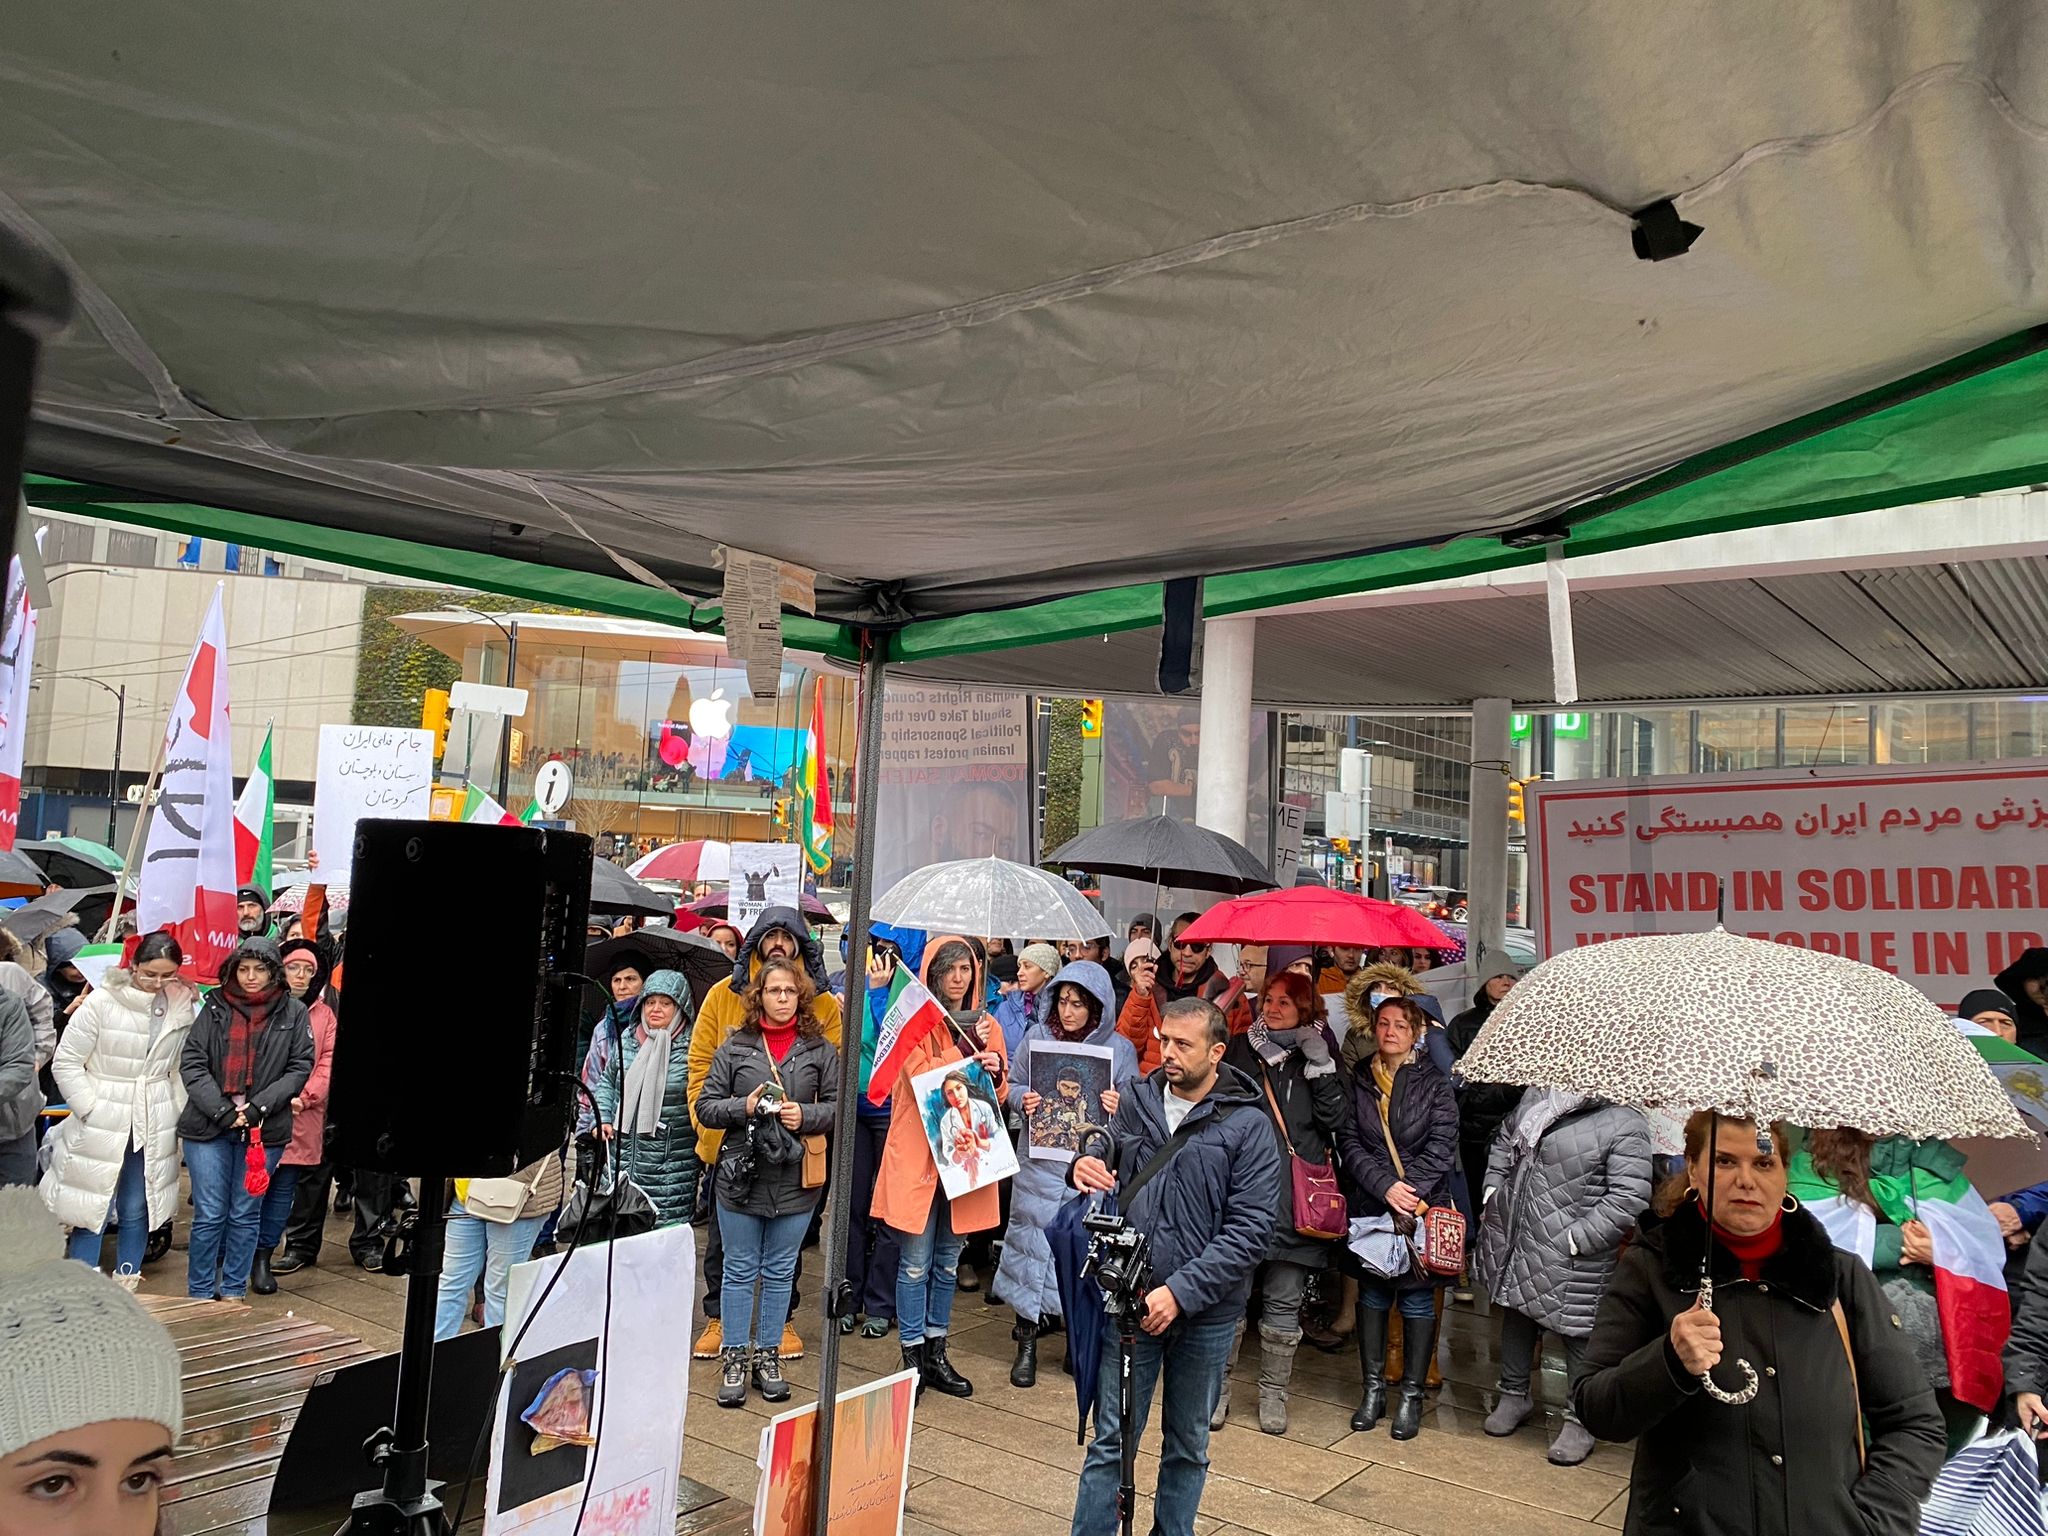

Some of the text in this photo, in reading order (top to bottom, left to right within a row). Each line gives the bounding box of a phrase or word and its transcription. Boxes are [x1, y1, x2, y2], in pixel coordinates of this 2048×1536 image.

[1567, 810, 1627, 844] کنید
[1635, 806, 1784, 842] همبستگی
[1795, 802, 1868, 836] ایران
[1879, 806, 1963, 834] مردم
[1568, 870, 1719, 914] STAND
[1732, 870, 1784, 912] IN
[1911, 931, 1970, 975] IN
